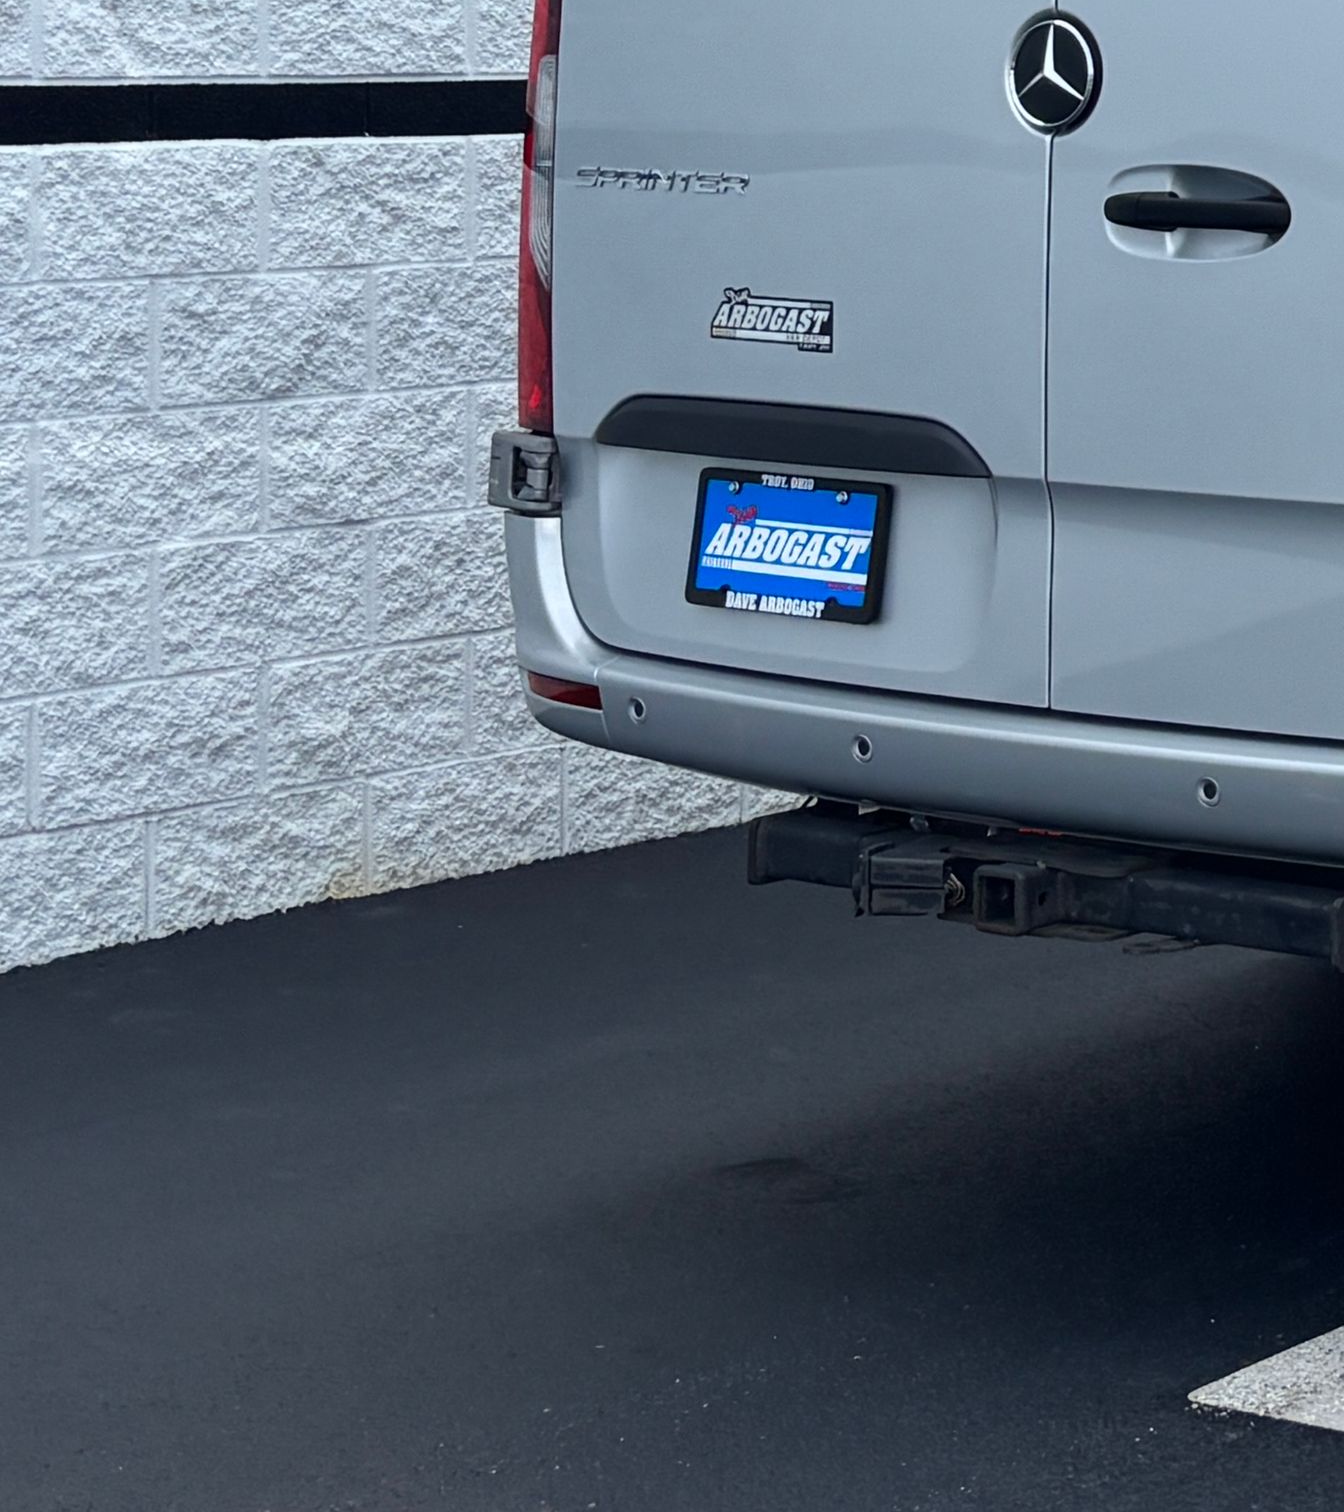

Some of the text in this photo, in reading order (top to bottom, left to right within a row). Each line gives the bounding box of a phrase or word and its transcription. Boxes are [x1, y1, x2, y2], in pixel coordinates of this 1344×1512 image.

[576, 166, 750, 196] SPRINTER
[713, 303, 830, 334] ARBOGAST
[790, 477, 815, 491] OHIO
[704, 522, 872, 571] ARBOGAST
[725, 590, 825, 619] DAVE ARBOGAST
